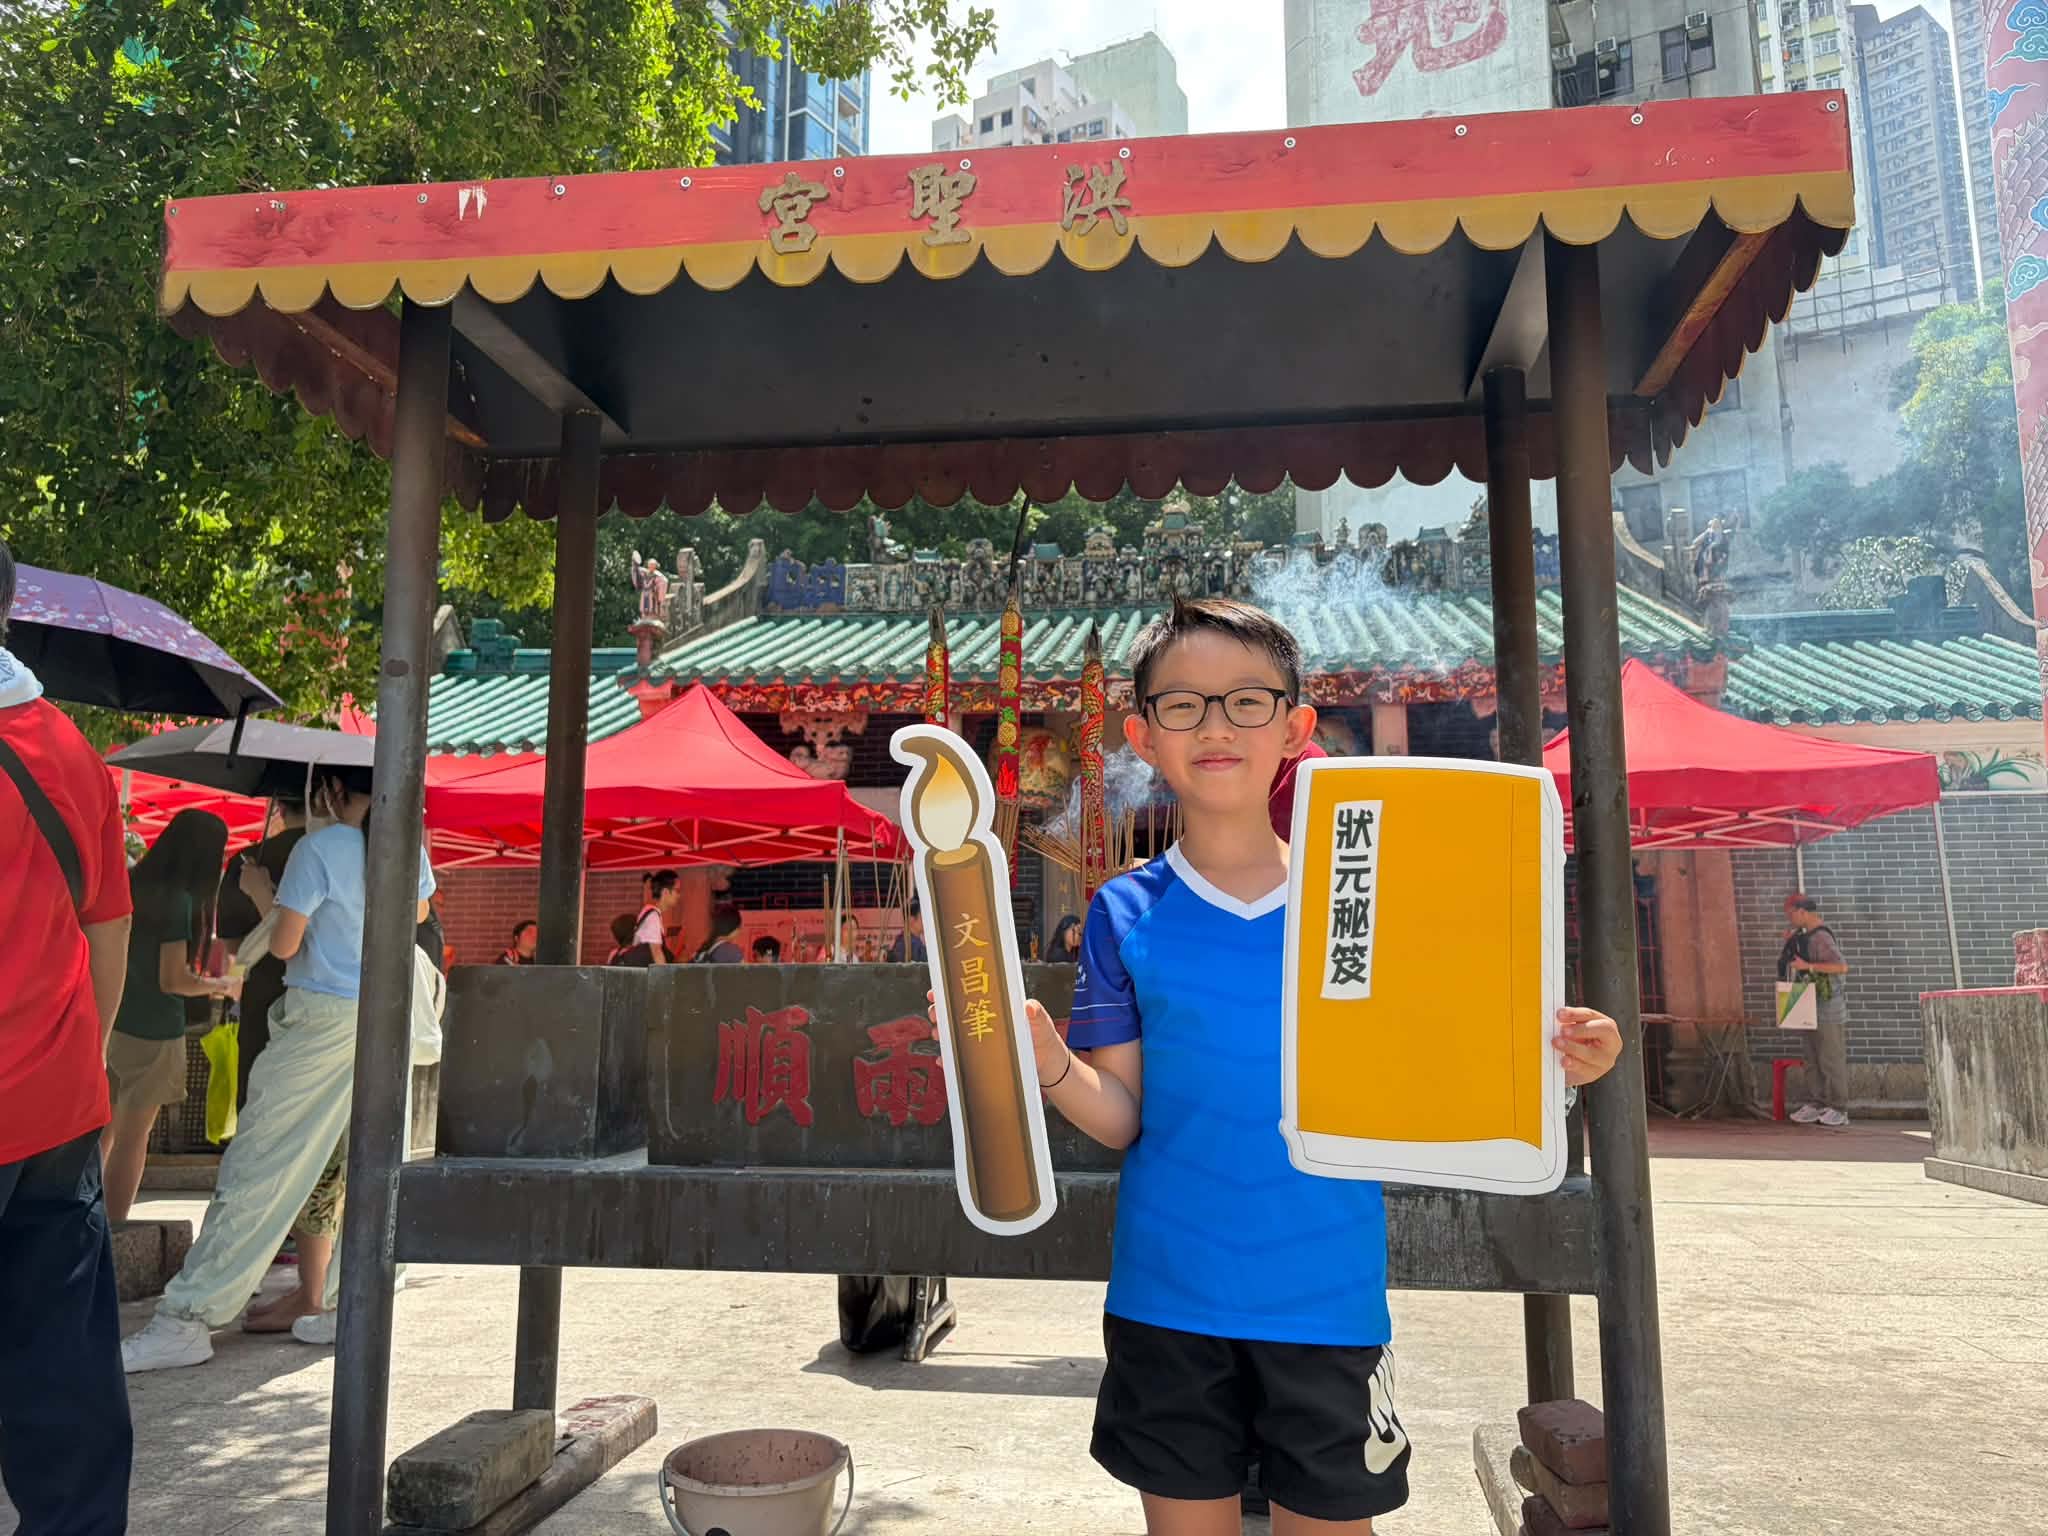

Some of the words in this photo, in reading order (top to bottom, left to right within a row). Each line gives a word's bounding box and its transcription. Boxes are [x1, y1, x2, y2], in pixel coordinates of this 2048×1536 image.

[1330, 808, 1374, 985] 狀元秘笈
[952, 912, 997, 1043] 文昌筆
